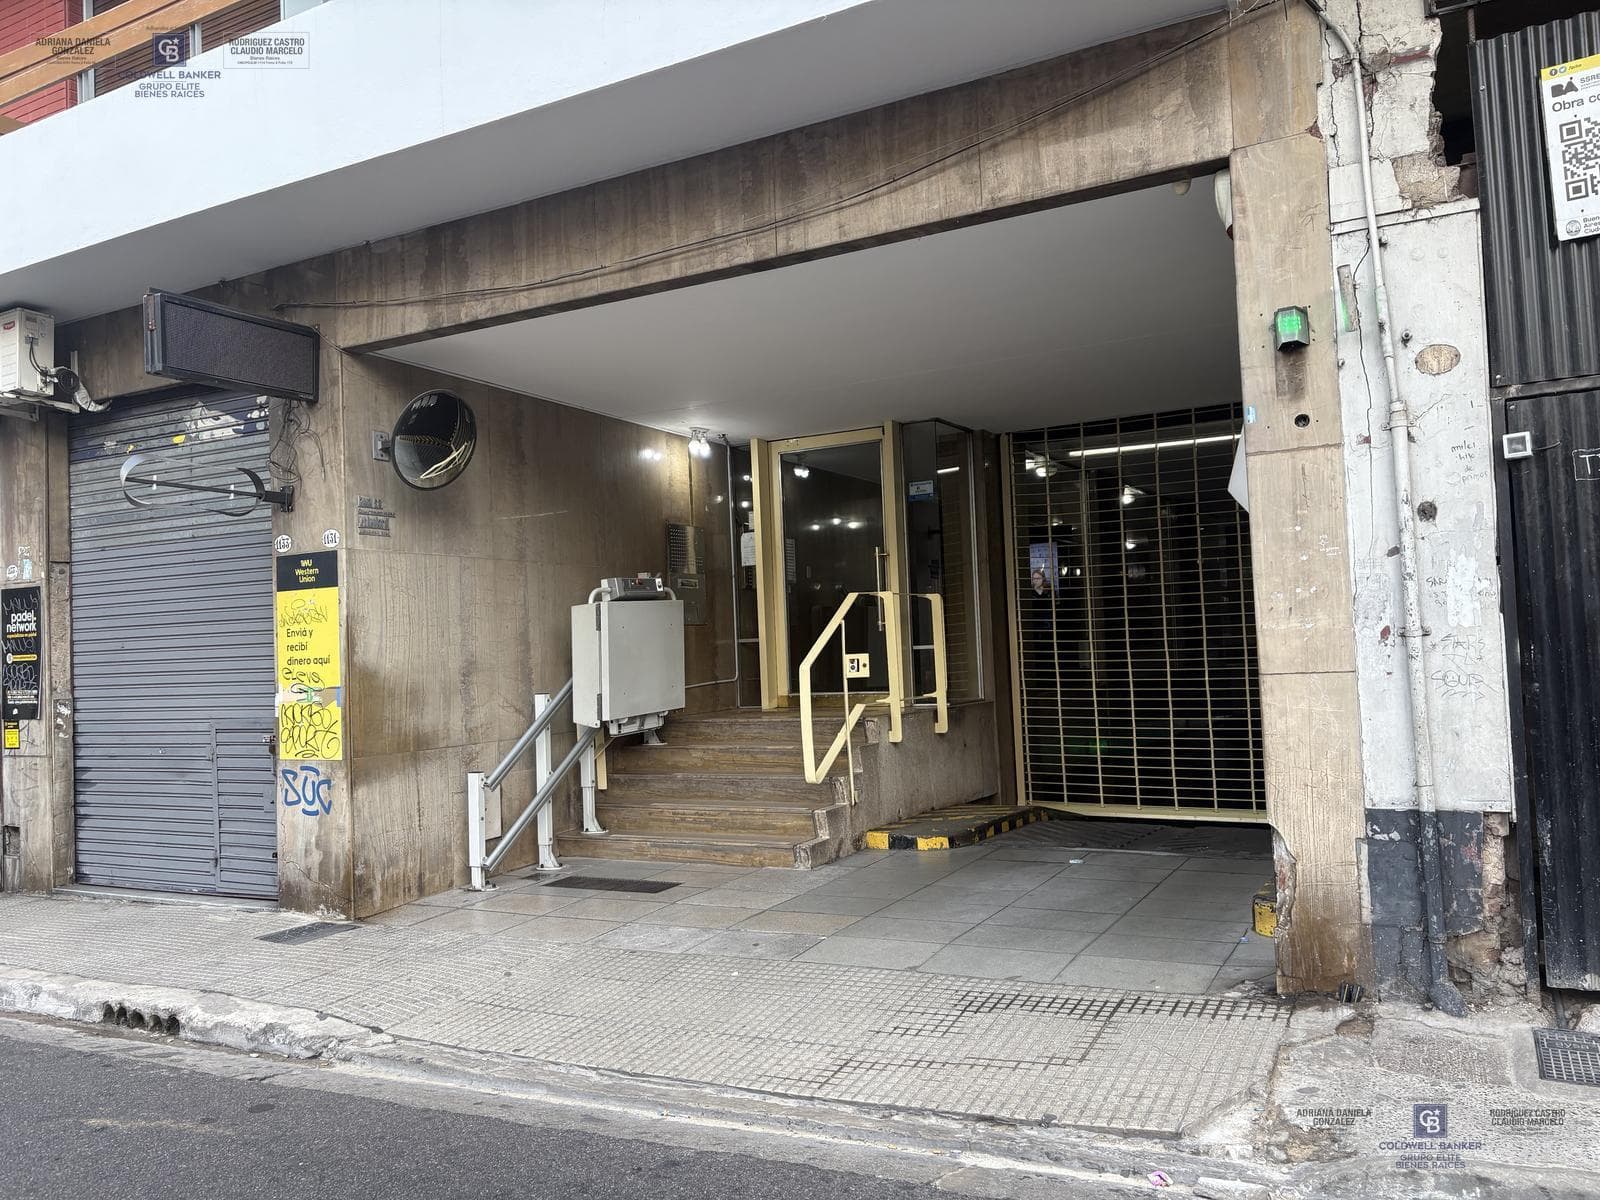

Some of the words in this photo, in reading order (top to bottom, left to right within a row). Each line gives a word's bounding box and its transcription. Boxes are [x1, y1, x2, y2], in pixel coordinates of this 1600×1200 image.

[1552, 98, 1584, 112] Obra
[6, 621, 37, 633] network
[308, 629, 314, 639] y
[286, 656, 311, 666] dinero
